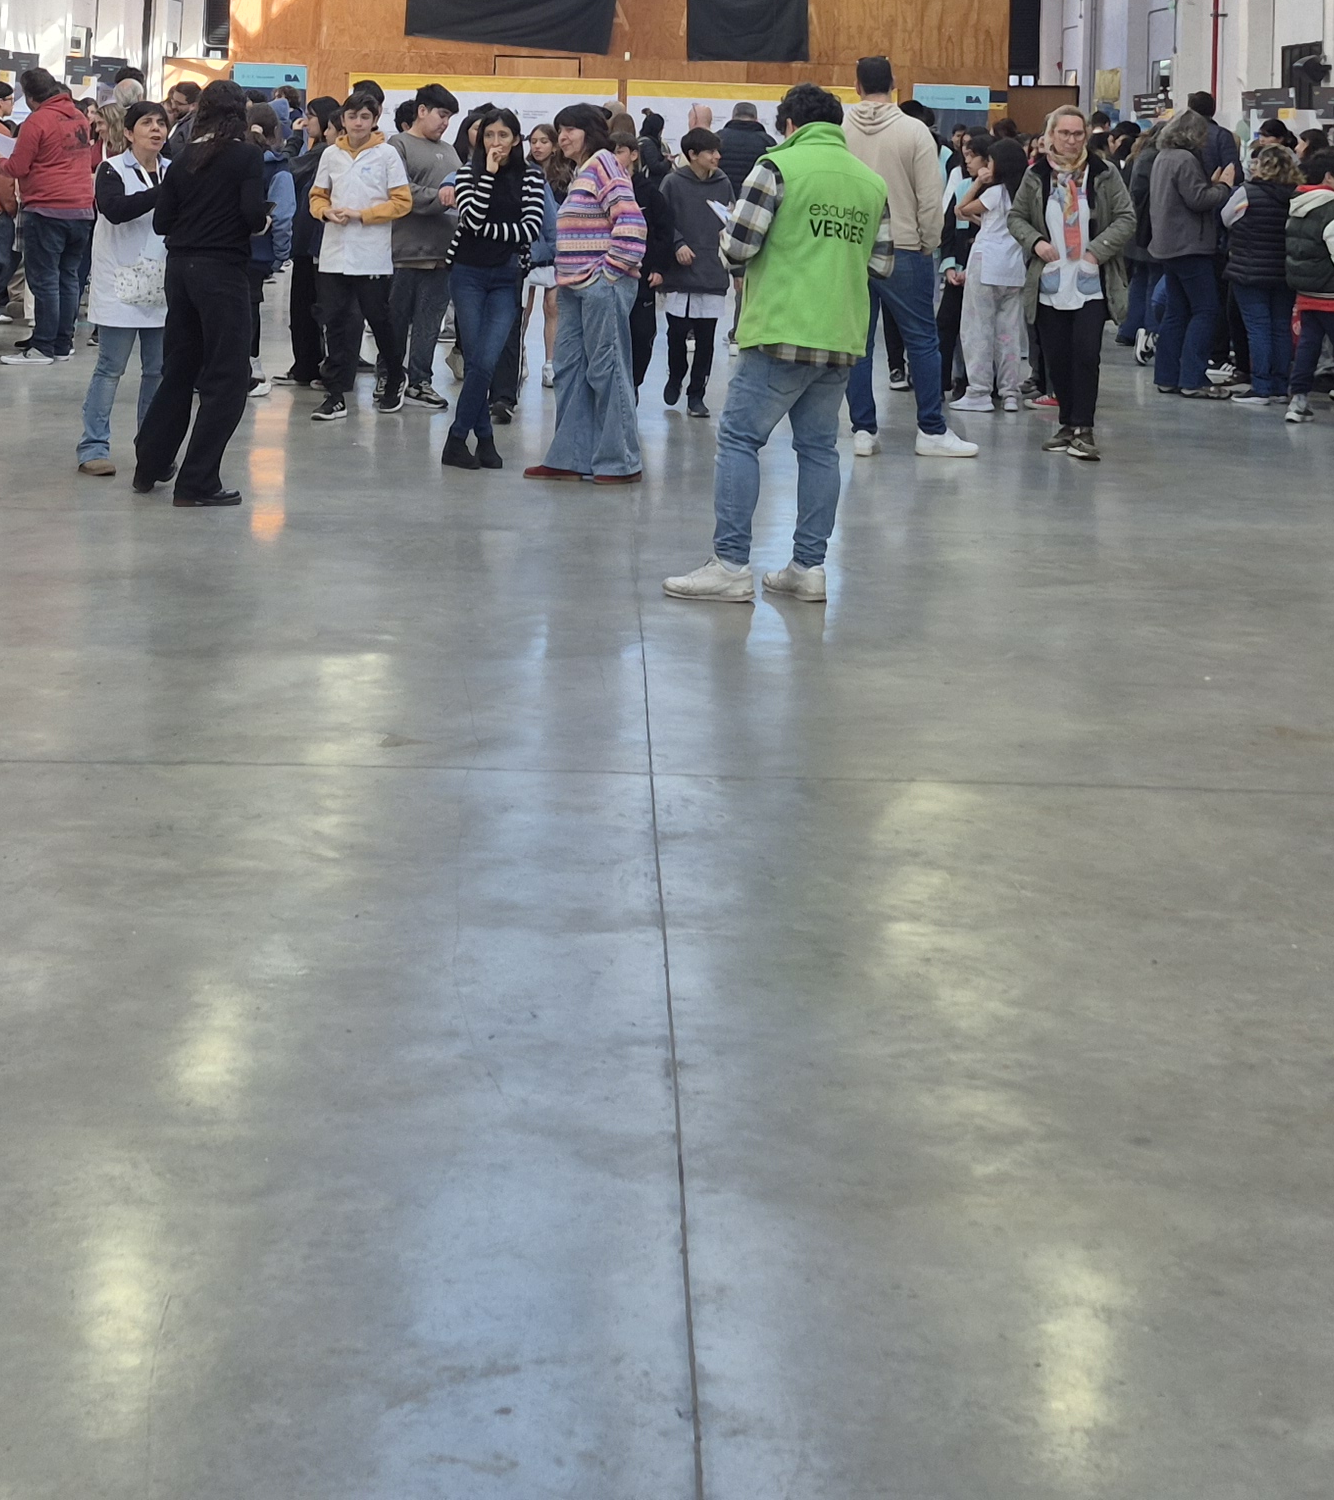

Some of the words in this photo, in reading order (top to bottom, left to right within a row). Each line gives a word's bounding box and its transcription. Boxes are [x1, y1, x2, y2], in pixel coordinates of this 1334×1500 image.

[284, 73, 300, 83] BA
[965, 95, 982, 104] BA
[809, 203, 870, 225] escuelas
[809, 218, 865, 245] VERDES
